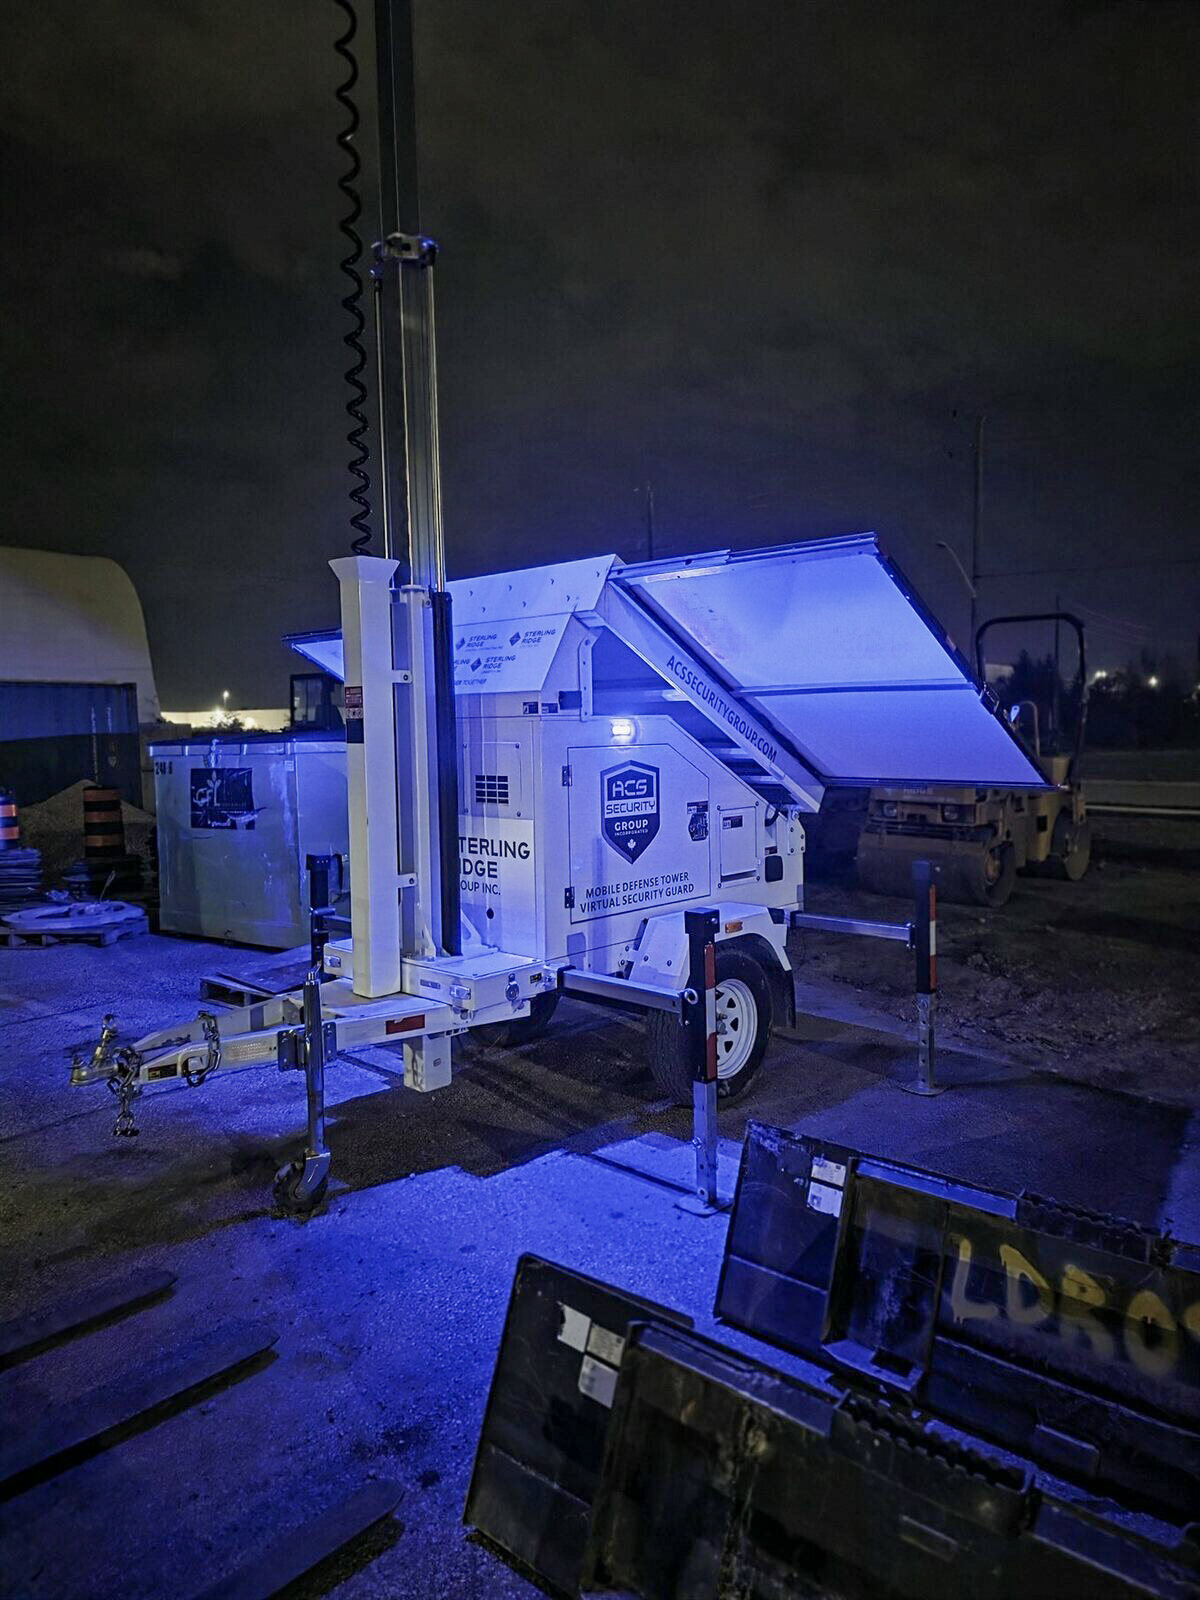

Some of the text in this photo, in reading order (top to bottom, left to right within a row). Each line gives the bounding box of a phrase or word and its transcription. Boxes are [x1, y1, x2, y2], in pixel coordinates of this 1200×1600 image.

[470, 633, 497, 641] STERLING
[524, 629, 556, 637] STERLING
[486, 655, 516, 663] STERLING
[666, 655, 777, 762] ACSSECURITYGROUP.COM
[612, 779, 647, 797] ACS
[606, 801, 656, 815] SECURITY
[614, 819, 649, 831] GROUP
[614, 828, 649, 836] INCORPORATED
[458, 836, 530, 860] TERLING
[462, 858, 498, 879] DGE
[460, 879, 501, 895] OUP INC.
[586, 871, 689, 899] MOBILE DEFENSE TOWER
[580, 883, 695, 913] VIRTUAL SECURITY GUARD
